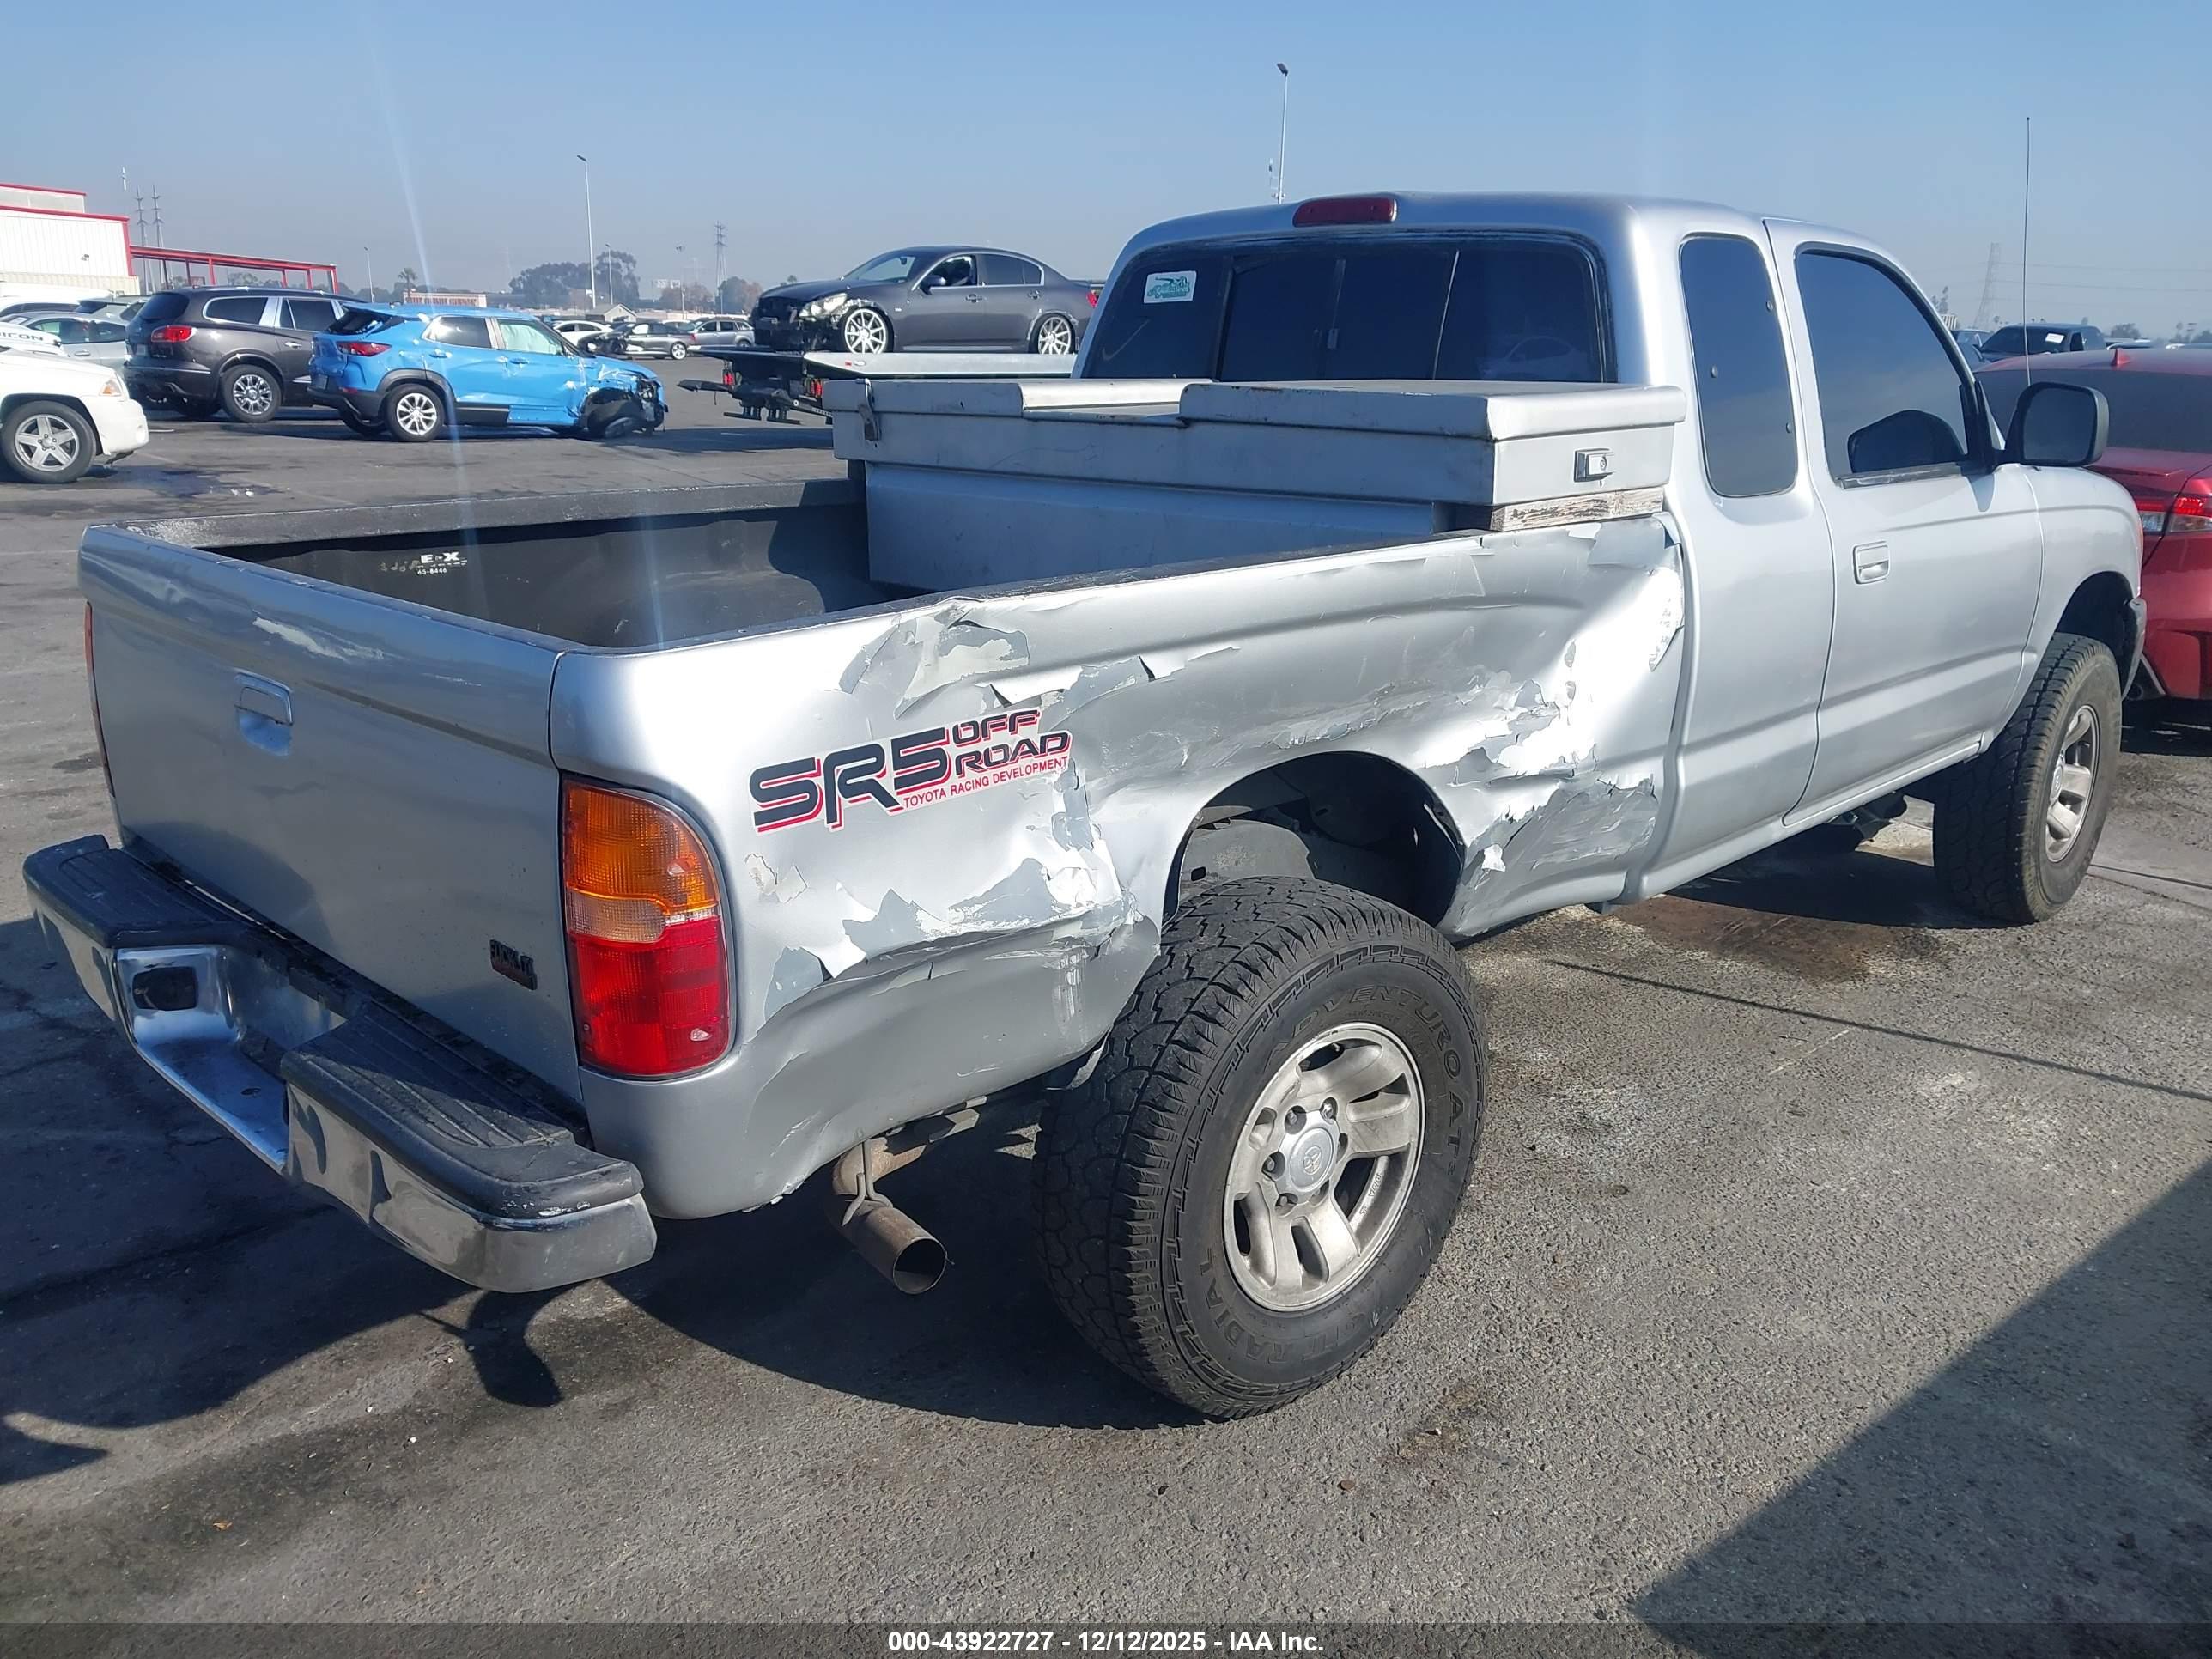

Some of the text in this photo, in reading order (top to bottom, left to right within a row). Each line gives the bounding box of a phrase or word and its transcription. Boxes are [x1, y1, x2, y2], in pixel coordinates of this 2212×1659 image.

[0, 332, 43, 341] ICON
[952, 709, 1041, 745] OFF
[750, 726, 1072, 832] SR5 ROAD
[903, 757, 1068, 809] TOYOTA RACING DEVELOPMENT
